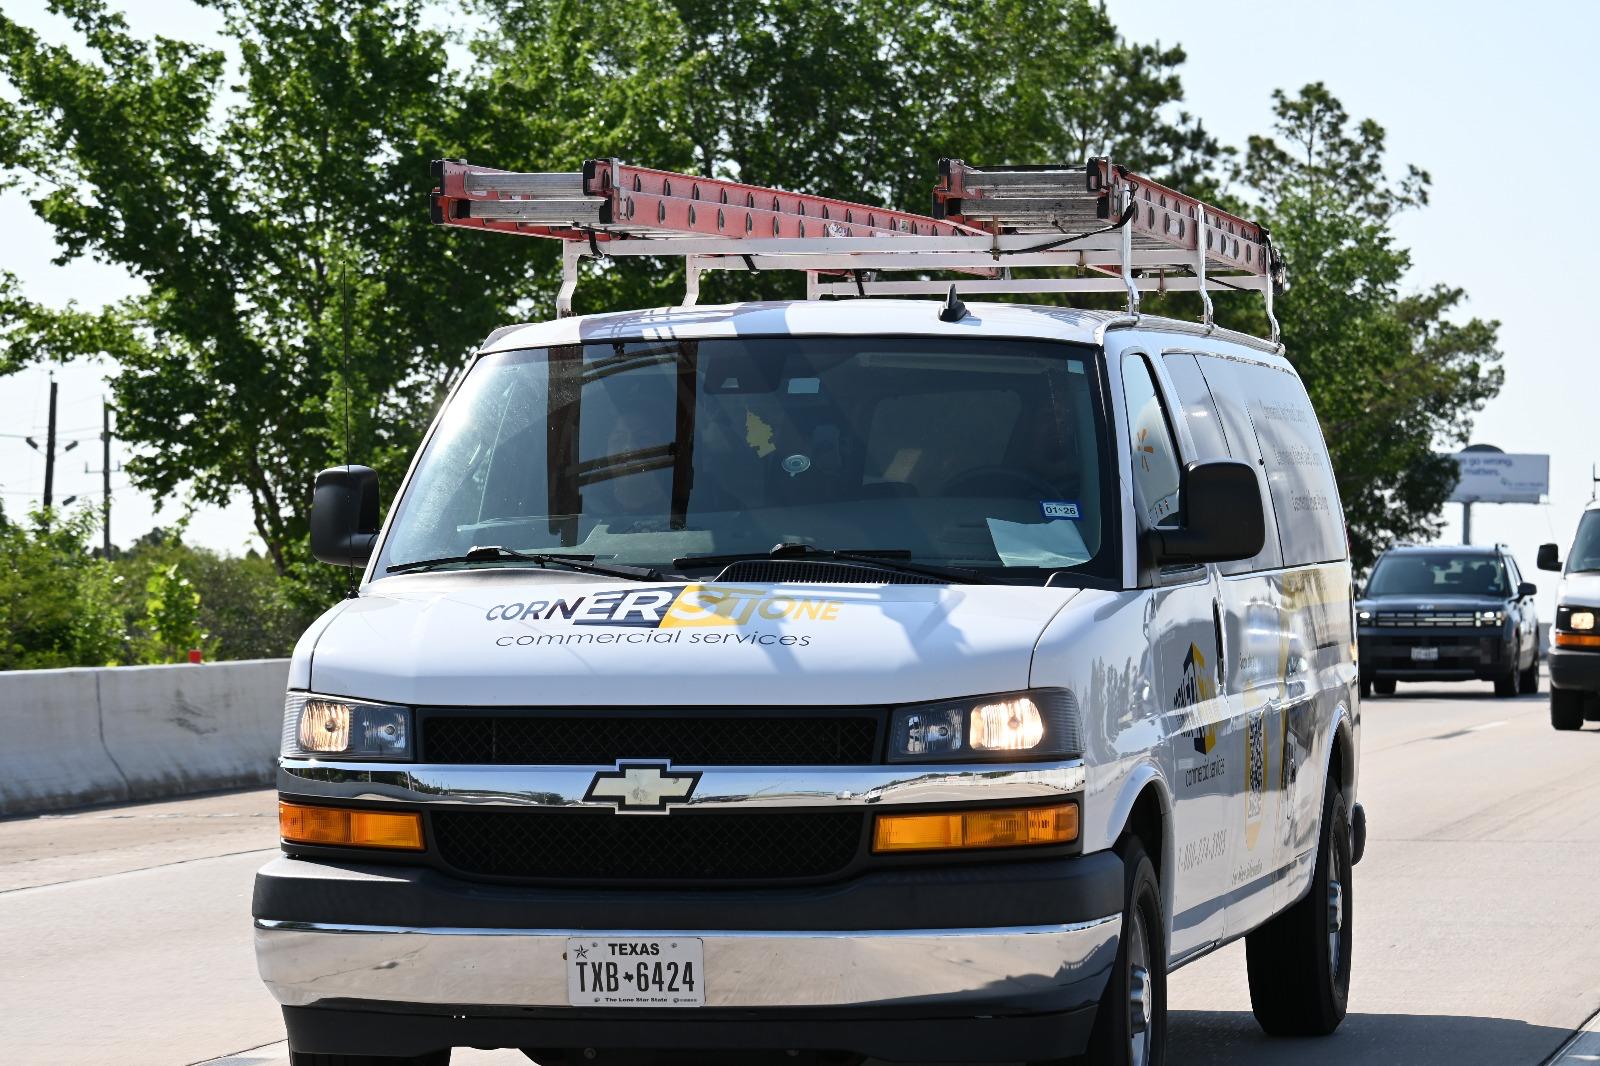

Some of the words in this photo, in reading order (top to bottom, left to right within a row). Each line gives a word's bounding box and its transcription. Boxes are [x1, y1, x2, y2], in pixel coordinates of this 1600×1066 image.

[485, 585, 844, 626] CORNERSTONE
[495, 629, 682, 647] commercial
[689, 629, 811, 647] services
[608, 943, 660, 956] TEXAS
[575, 961, 619, 992] TXB
[636, 961, 695, 992] 6424
